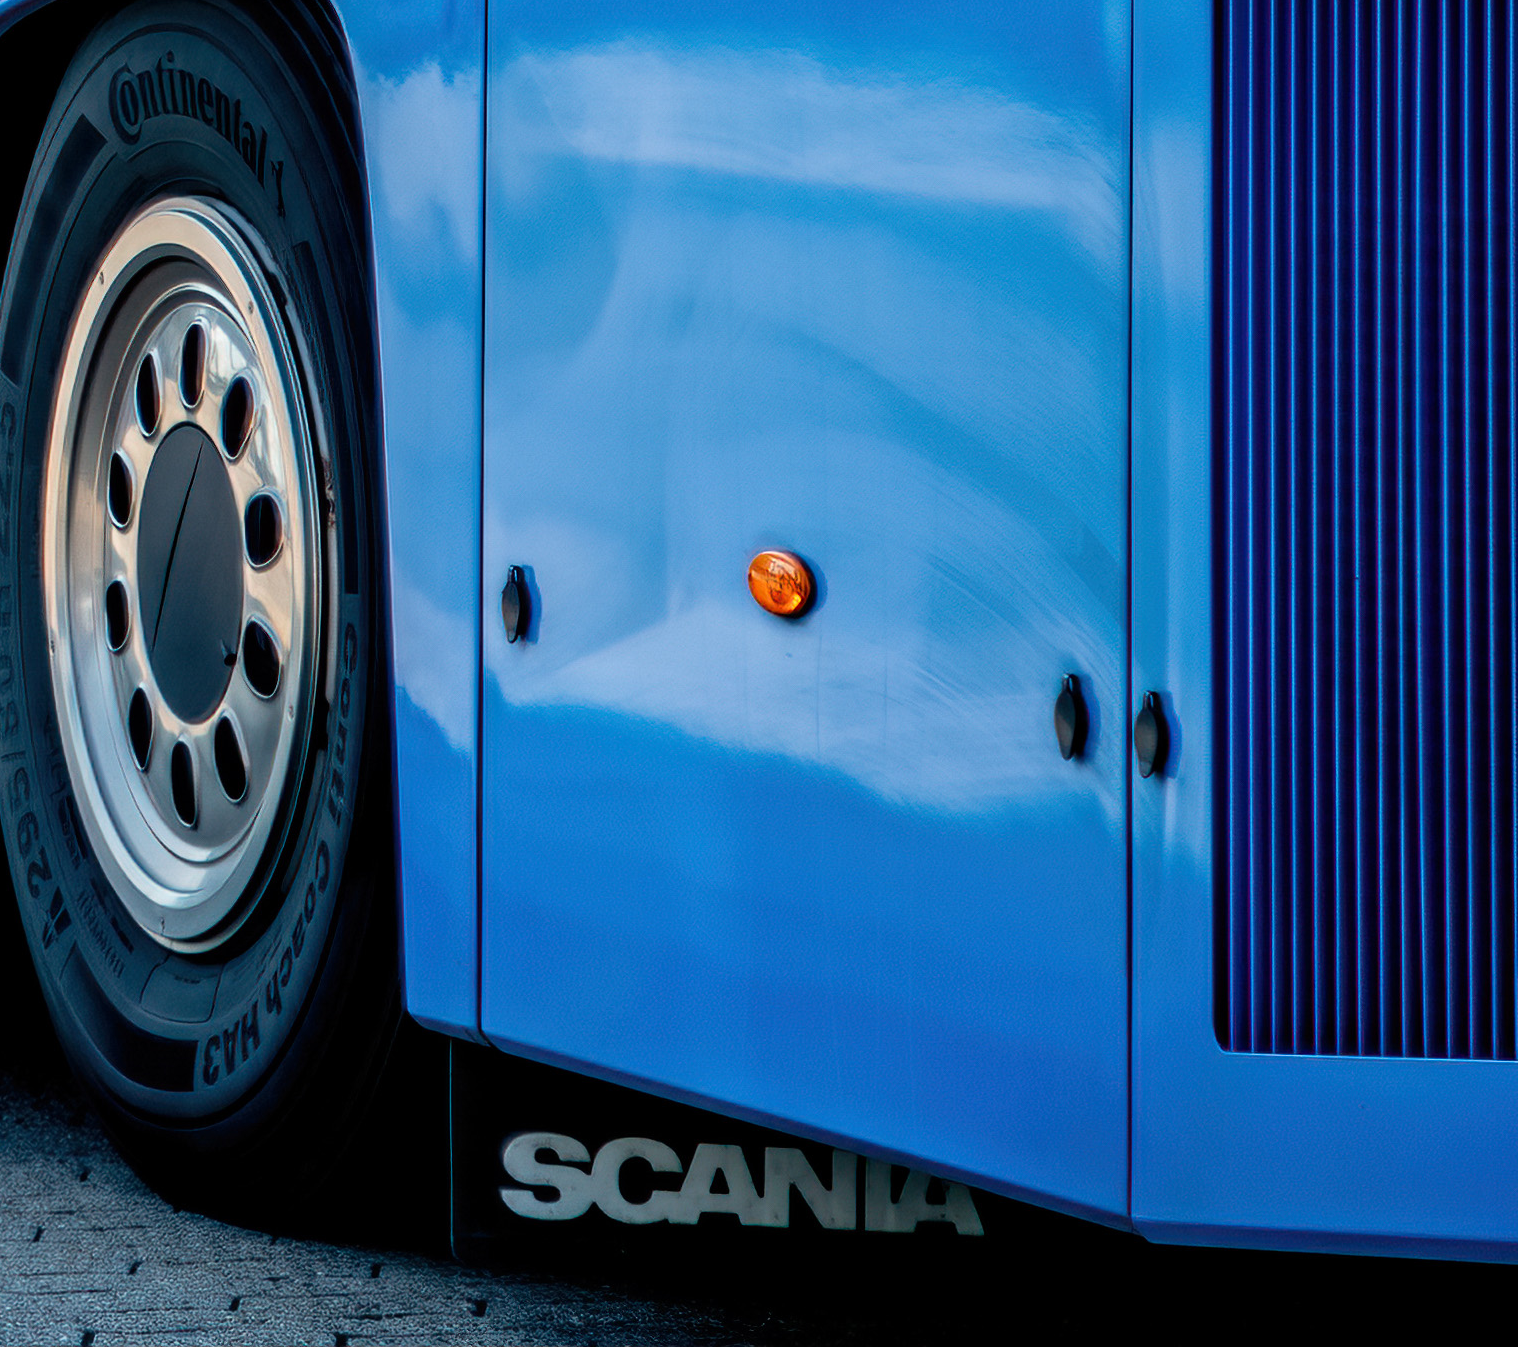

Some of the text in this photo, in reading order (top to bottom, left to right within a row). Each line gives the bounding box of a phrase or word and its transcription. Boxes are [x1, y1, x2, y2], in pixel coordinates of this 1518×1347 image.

[108, 48, 267, 189] Continental
[264, 840, 332, 1017] Coach
[499, 1131, 985, 1236] SCANIA
